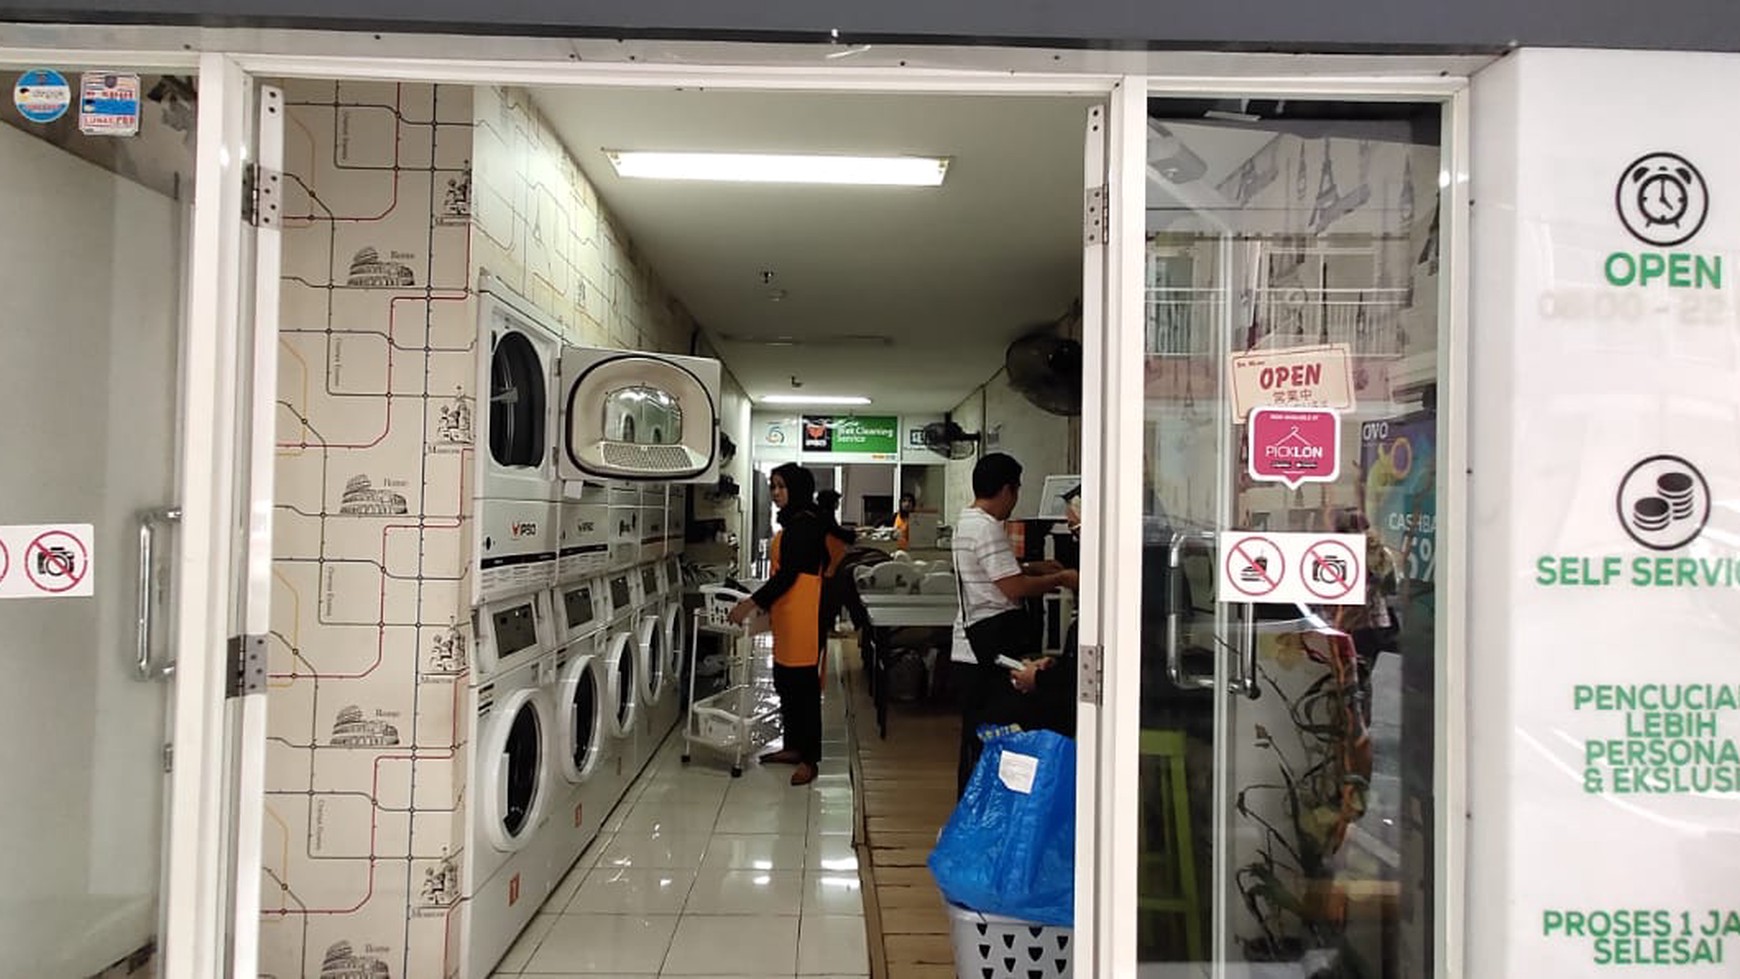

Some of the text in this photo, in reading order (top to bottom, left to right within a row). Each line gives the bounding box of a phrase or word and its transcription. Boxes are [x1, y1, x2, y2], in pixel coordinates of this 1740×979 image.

[1604, 252, 1722, 289] OPEN
[1259, 363, 1322, 390] OPEN
[1363, 422, 1389, 440] OVO
[1265, 446, 1323, 458] PICKLON
[1536, 556, 1740, 587] SELF SERVI
[1573, 684, 1740, 711] PENCUCIA
[1626, 712, 1717, 738] LEBIH
[1585, 739, 1740, 766] PERSONA
[1583, 768, 1603, 793] &
[1543, 910, 1672, 937] PROSES
[1680, 911, 1693, 936] 1
[1593, 938, 1723, 965] SELESAI
